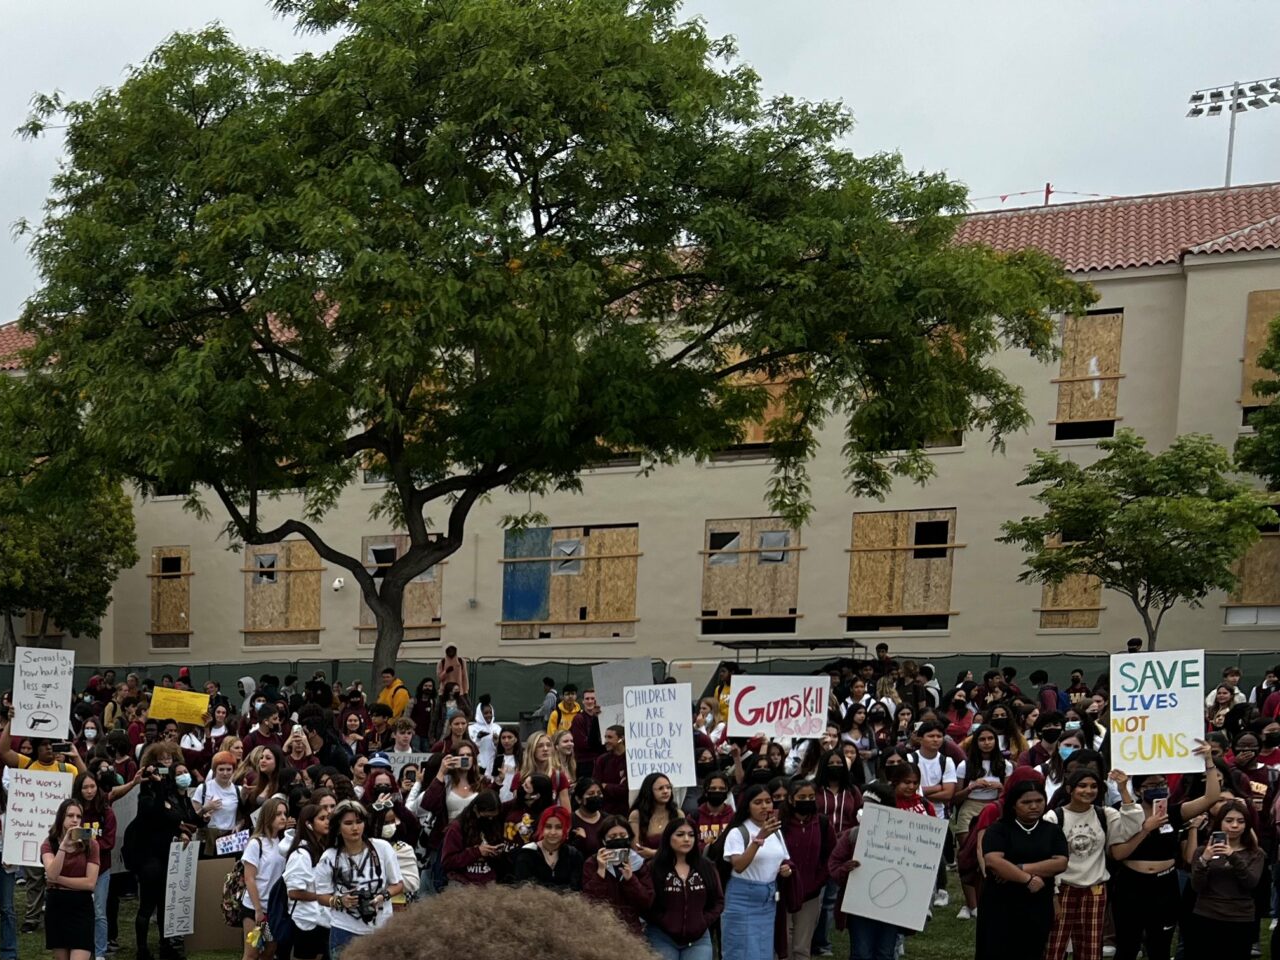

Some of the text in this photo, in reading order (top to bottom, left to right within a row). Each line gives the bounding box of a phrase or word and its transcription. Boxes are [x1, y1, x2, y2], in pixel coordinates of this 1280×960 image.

[1119, 659, 1200, 693] SAVE
[23, 680, 38, 691] less
[19, 701, 33, 710] less
[625, 687, 677, 709] CHILDREN
[1112, 692, 1178, 711] LIVES
[646, 706, 665, 721] ARE
[629, 721, 684, 739] KILLED BY
[1112, 715, 1149, 733] NOT
[645, 737, 672, 750] GUN
[1121, 733, 1190, 761] GUNS
[626, 748, 674, 761] VIOLENCE
[13, 773, 61, 788] the worst
